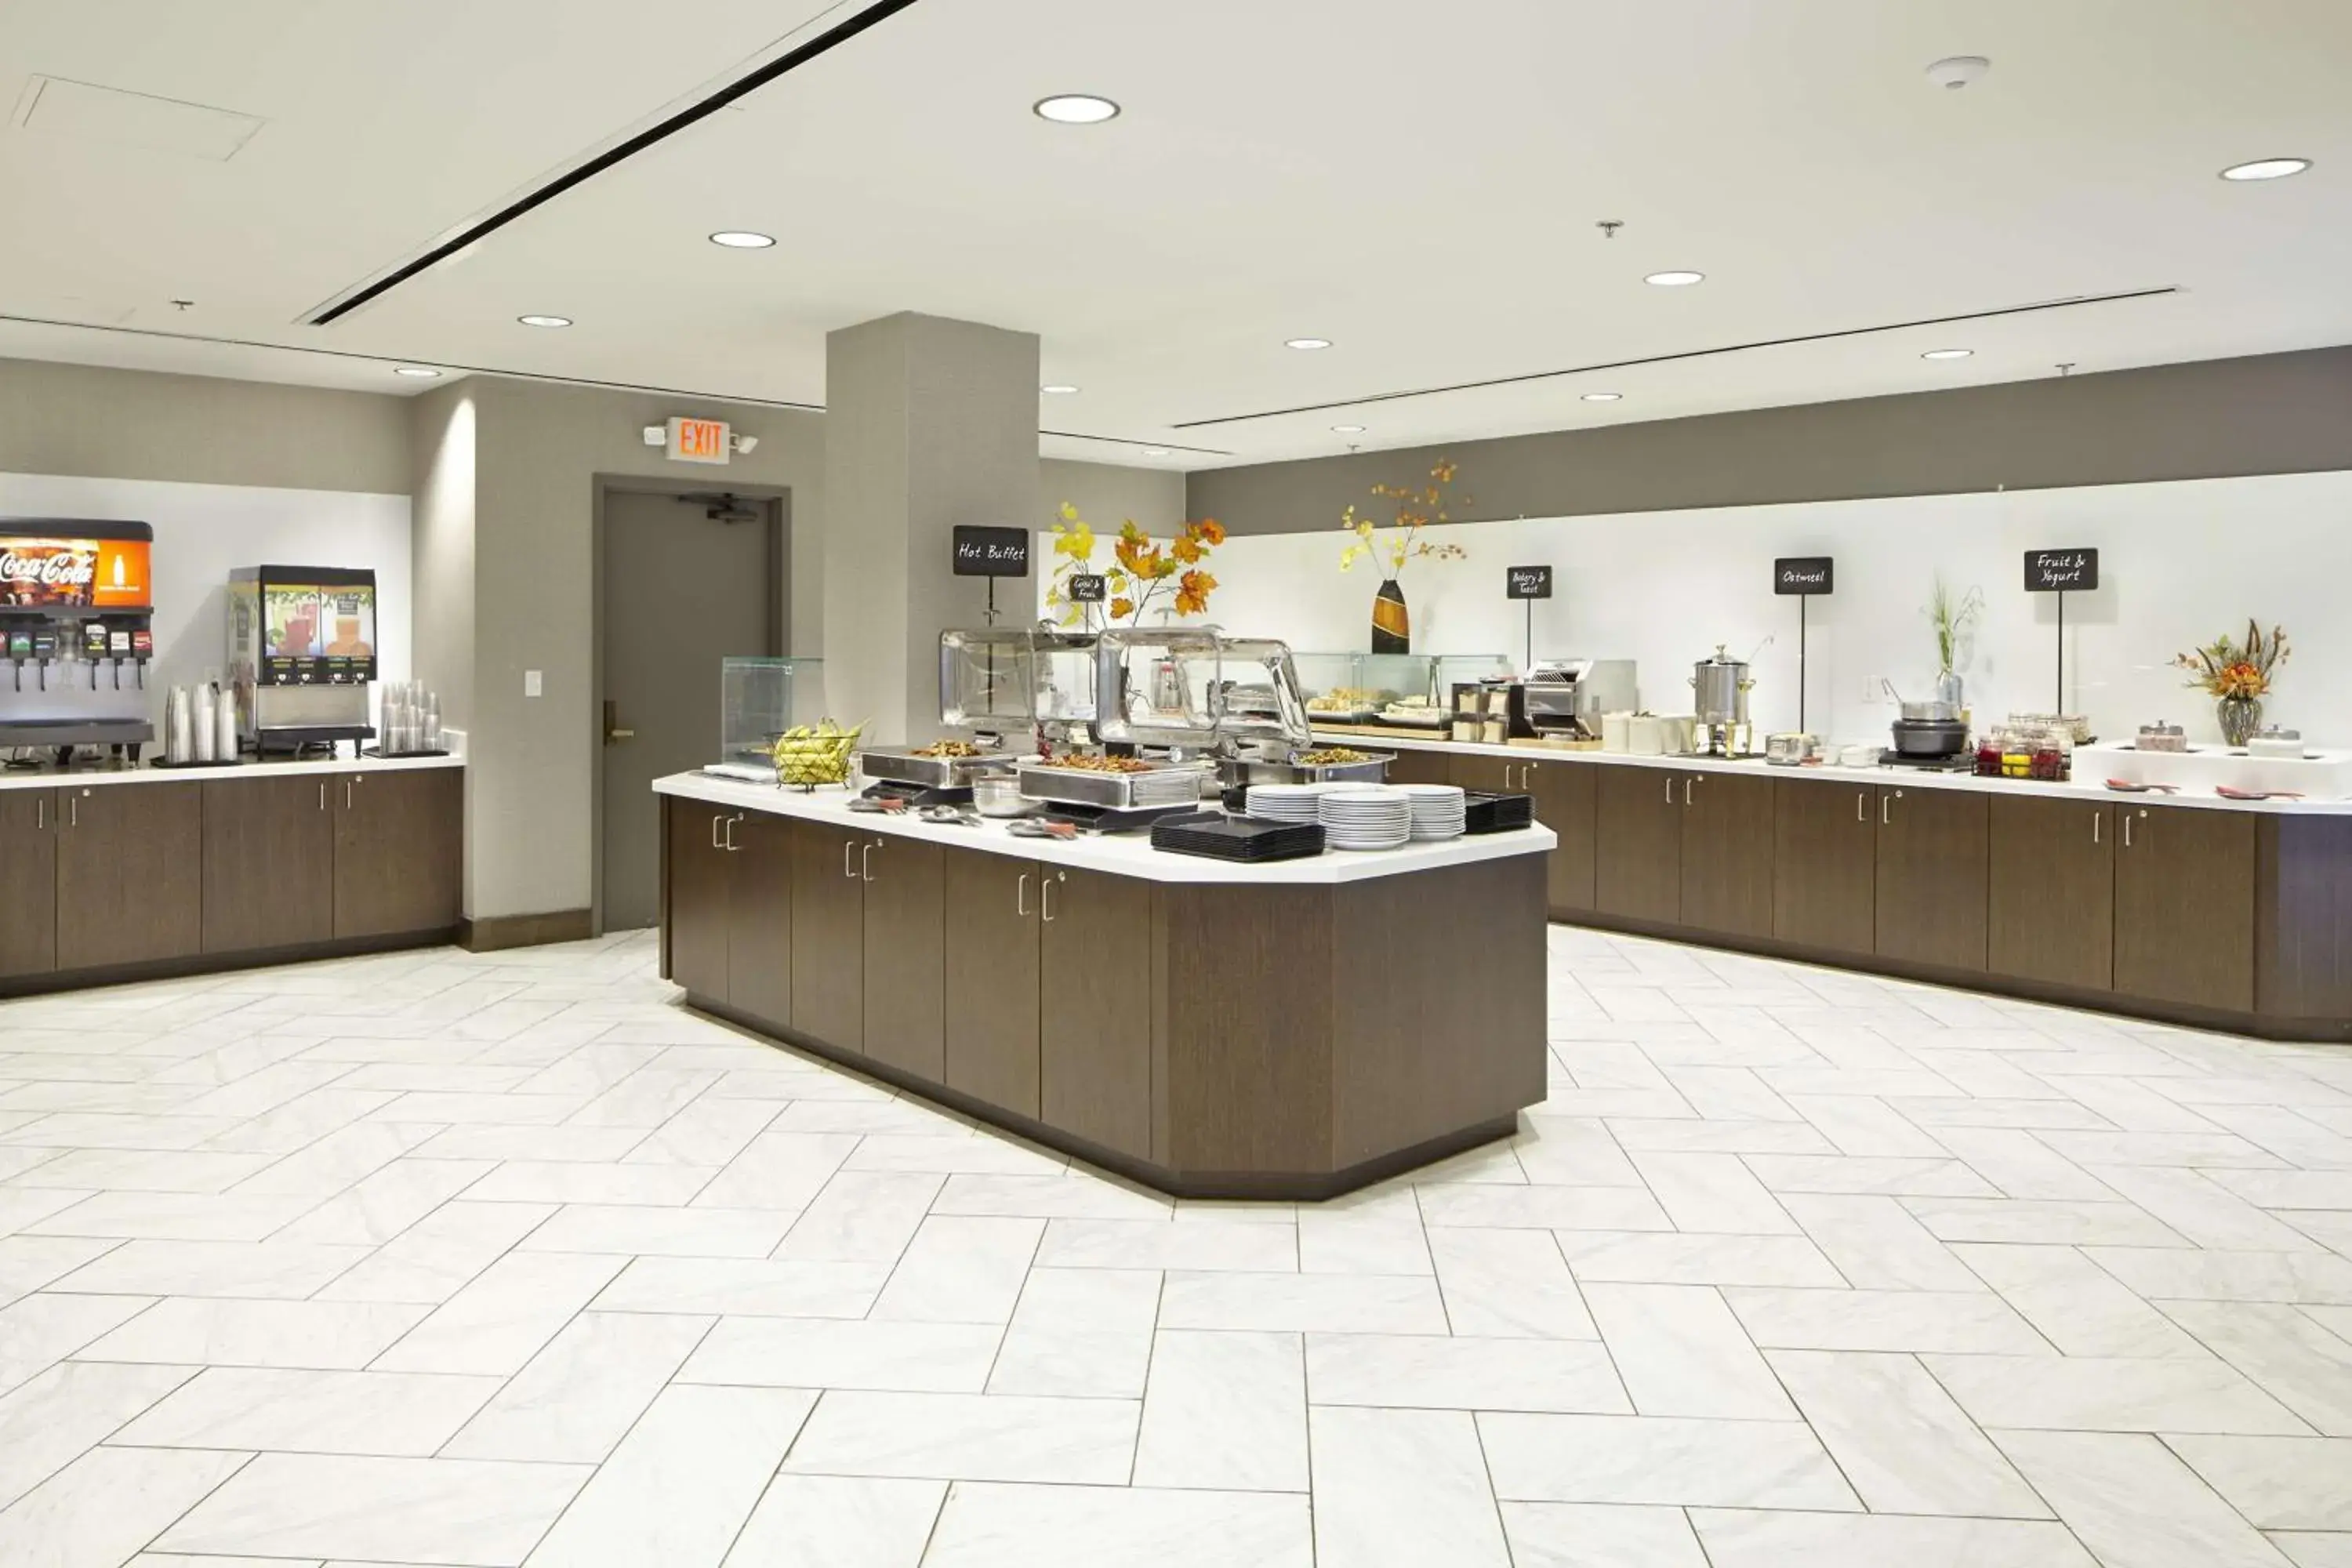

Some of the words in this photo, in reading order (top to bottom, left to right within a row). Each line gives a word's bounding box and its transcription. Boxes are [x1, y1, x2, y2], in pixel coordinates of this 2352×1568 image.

[680, 421, 722, 457] EXIT
[959, 543, 981, 558] Hot
[988, 545, 1025, 561] Buffet
[2038, 554, 2071, 567] Fruit
[2074, 554, 2085, 568] &
